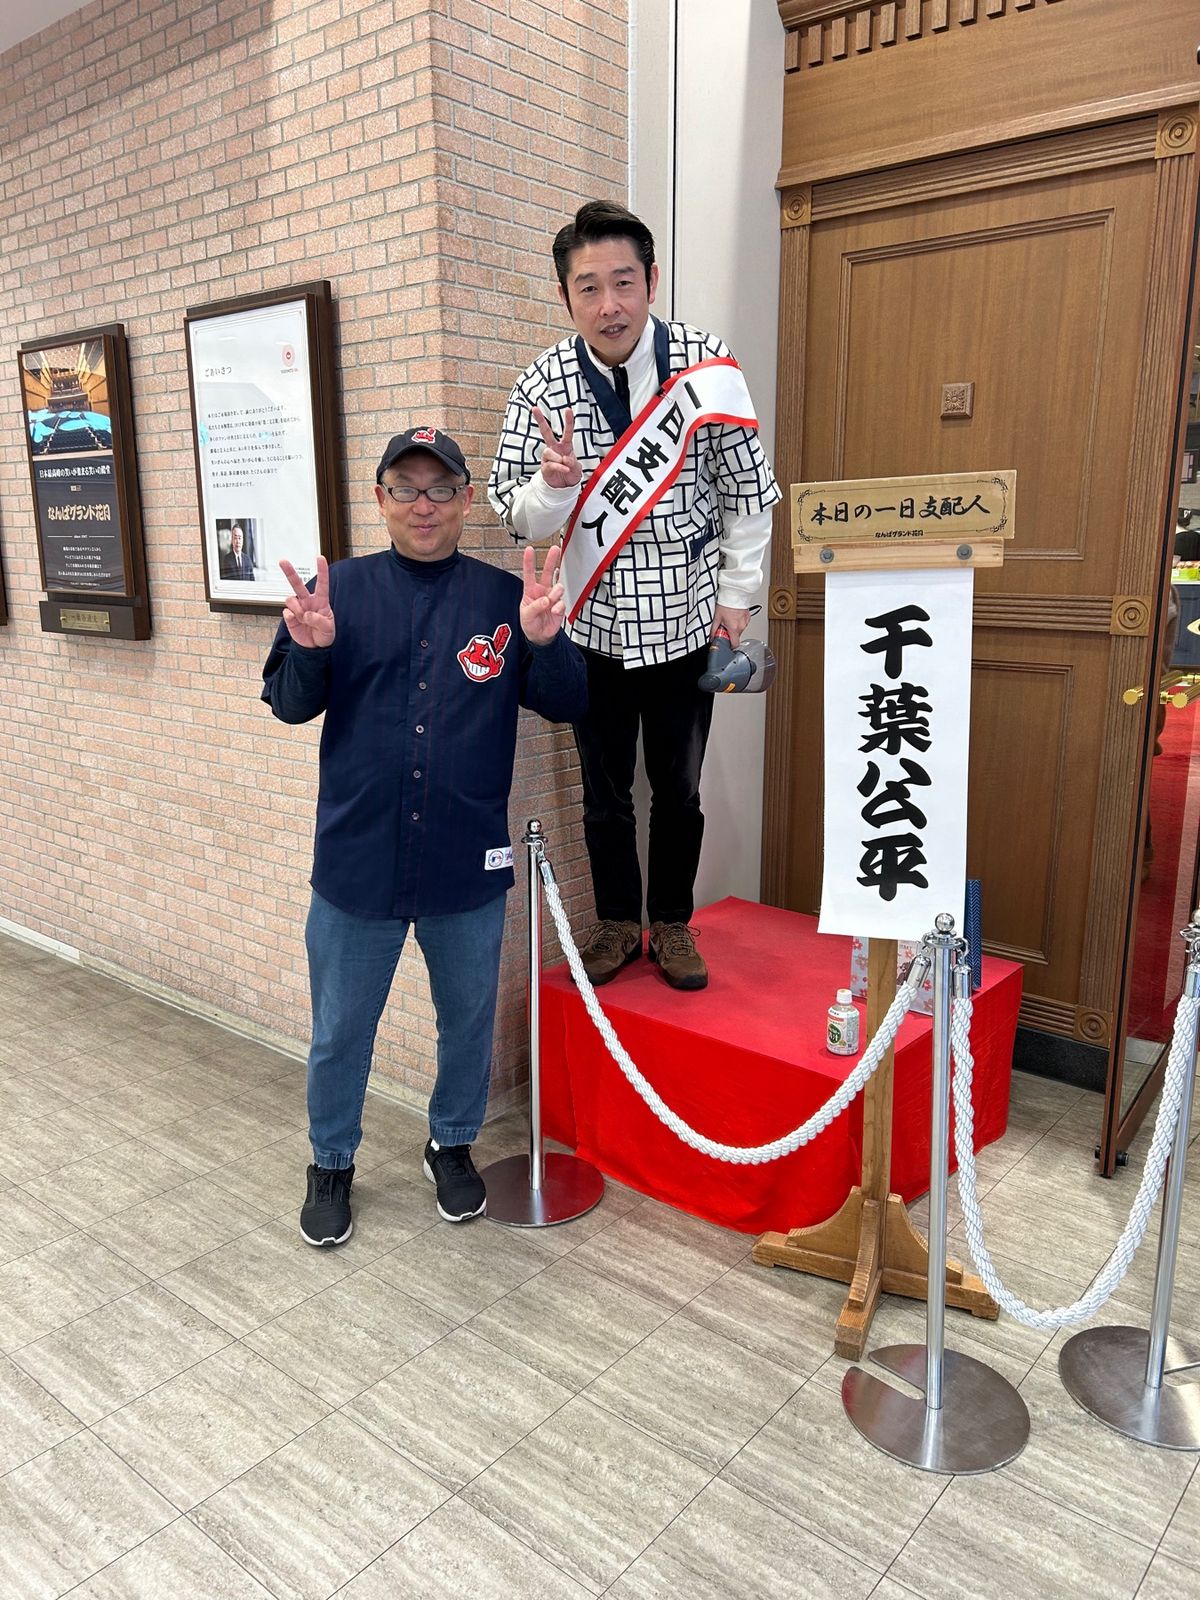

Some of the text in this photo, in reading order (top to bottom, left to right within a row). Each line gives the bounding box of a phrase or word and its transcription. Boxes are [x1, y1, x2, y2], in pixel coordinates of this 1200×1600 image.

[204, 366, 232, 377] ごあいさつ
[582, 381, 702, 547] 一日支配人
[47, 503, 111, 521] なんばグランド花月
[810, 494, 991, 526] 本日の一日支配人
[875, 529, 924, 538] なんばグランド花月
[856, 604, 933, 902] 千葉公平
